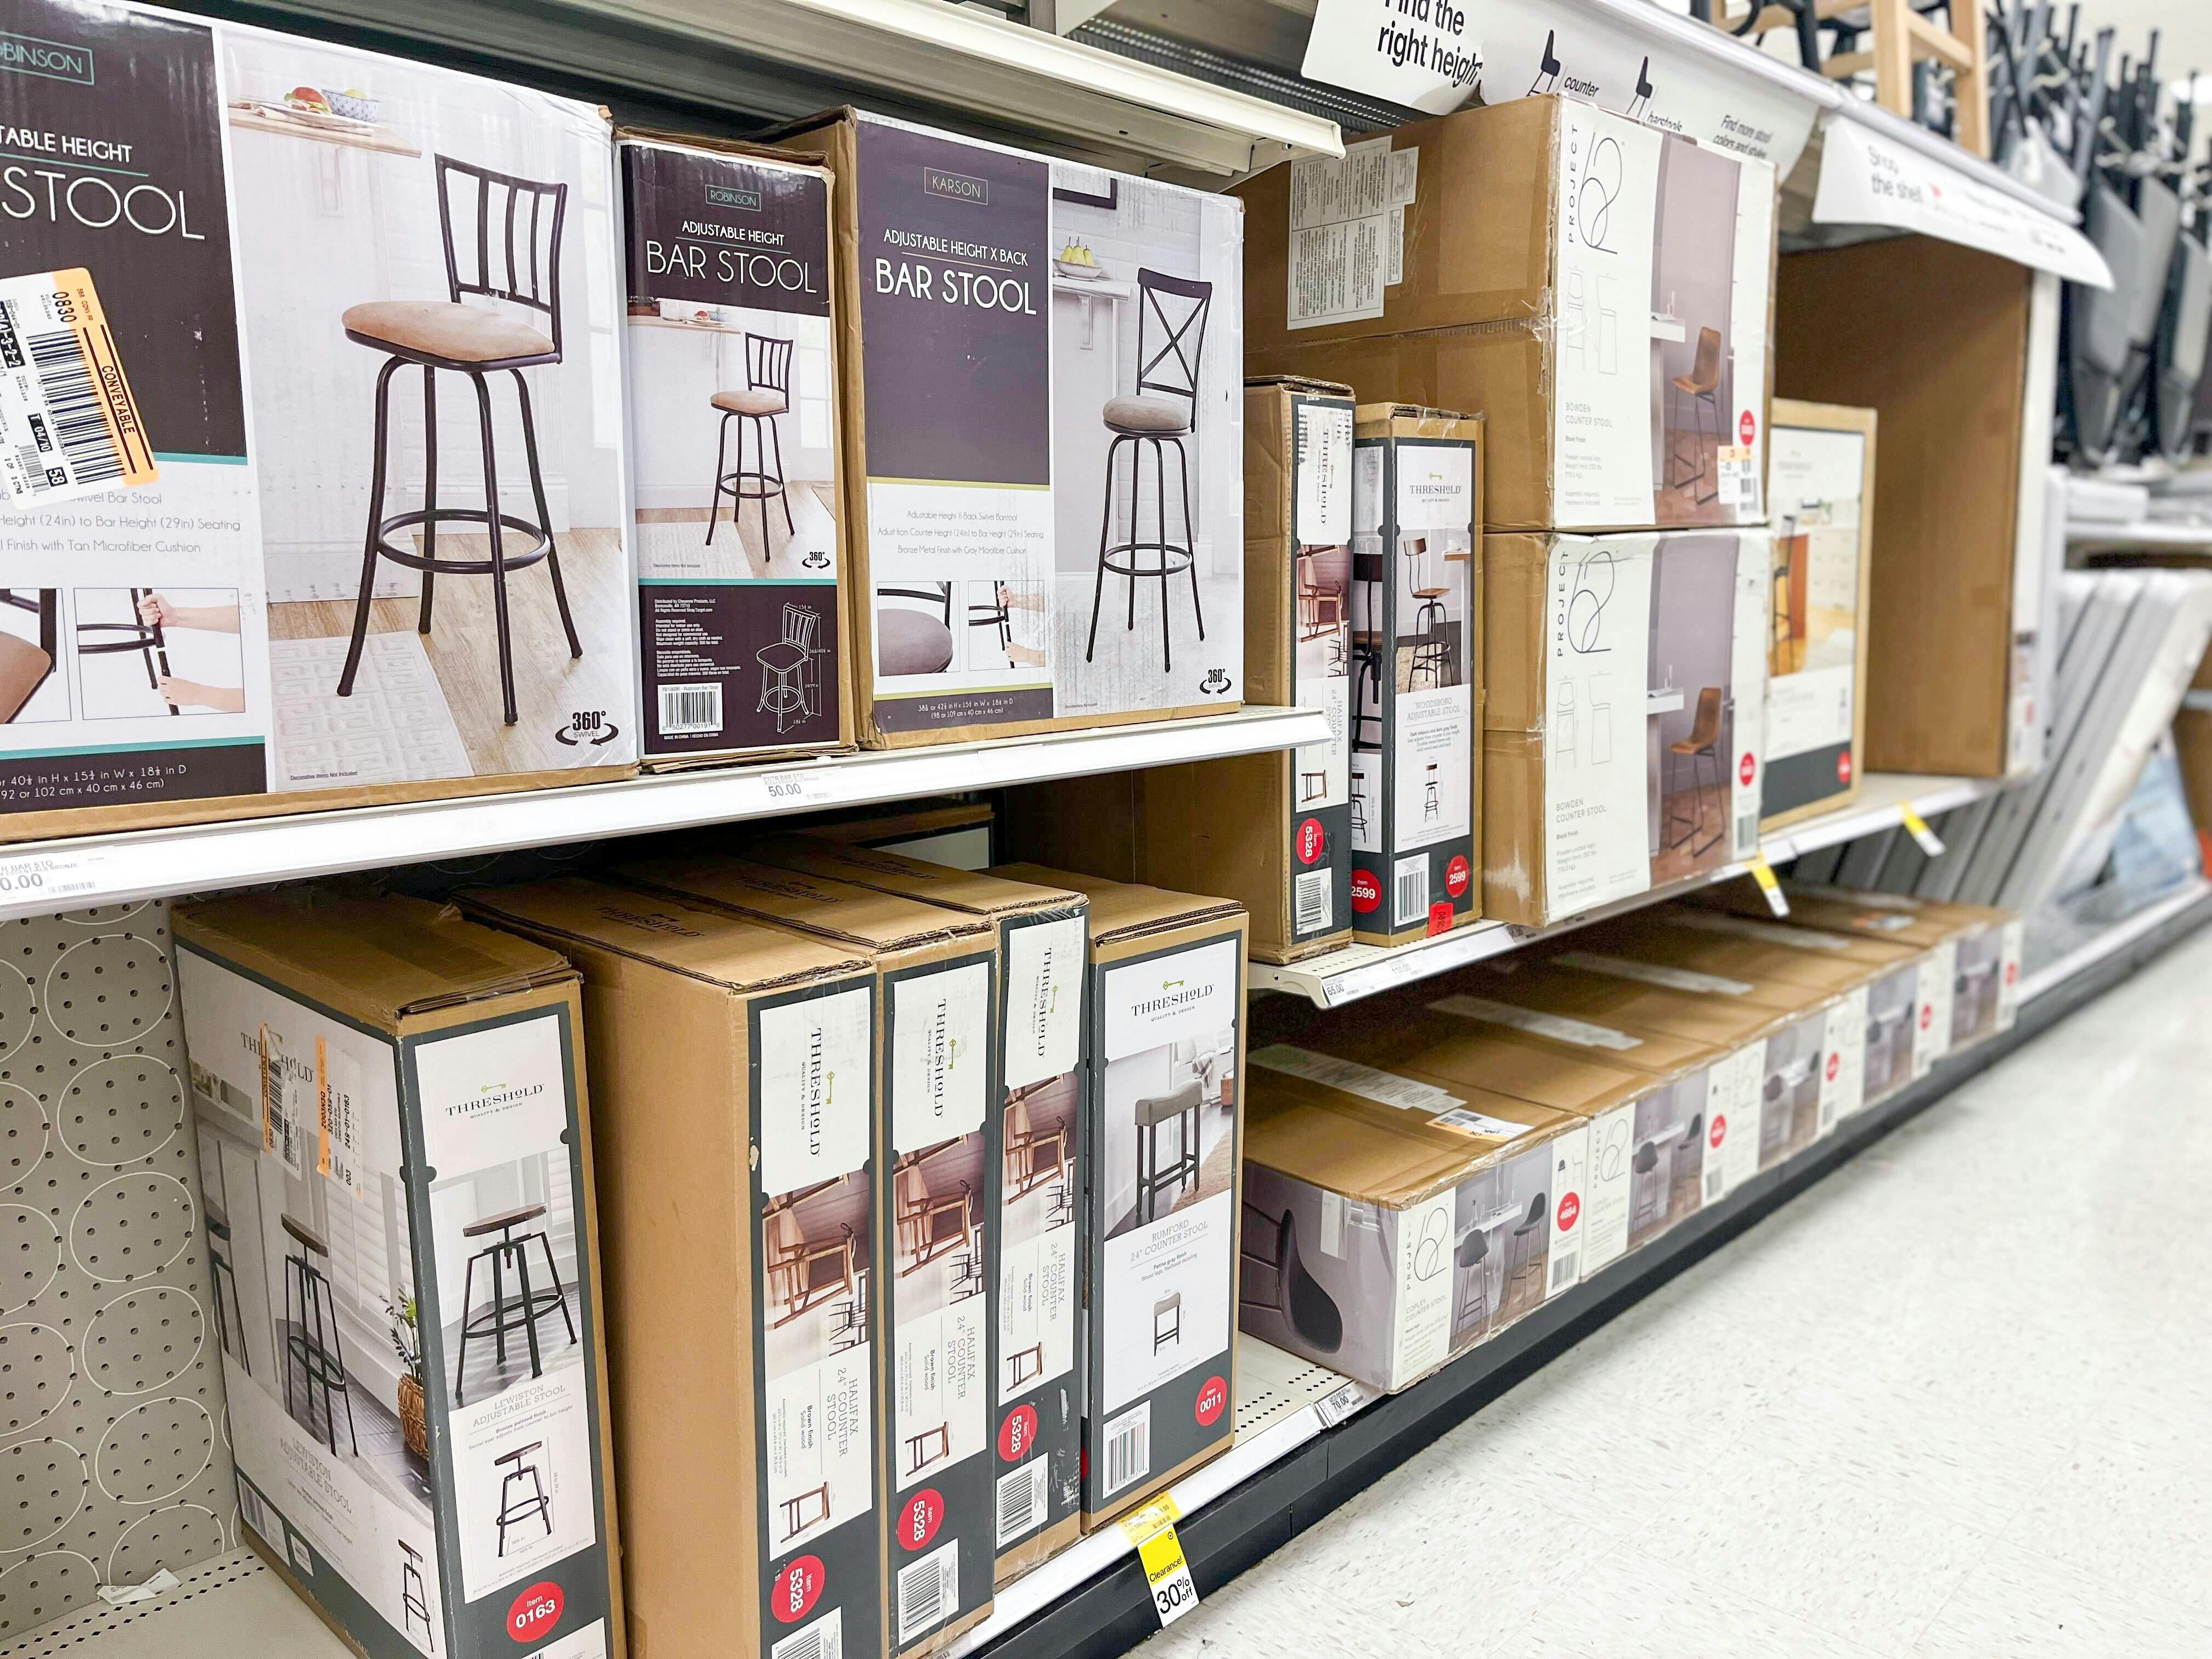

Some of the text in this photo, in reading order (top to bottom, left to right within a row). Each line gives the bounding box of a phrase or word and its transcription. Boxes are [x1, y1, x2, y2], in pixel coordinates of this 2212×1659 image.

[1435, 0, 1464, 36] the
[1378, 21, 1428, 67] right
[1564, 76, 1599, 97] counter
[1721, 114, 1737, 131] Find
[62, 137, 132, 162] HEIGHT
[933, 176, 980, 198] KARSON
[1568, 124, 1578, 242] PROJECT
[2, 166, 205, 240] STOOL
[710, 190, 757, 207] ROBINSON
[682, 221, 785, 246] ADJUSTABLE HEIGHT
[884, 228, 1028, 266] ADJUSTABLE HEIGHT X BACK
[646, 240, 817, 294] BAR STOOL
[876, 258, 1036, 315] BAR STOOL
[53, 292, 77, 323] 0830
[101, 365, 135, 433] CONVEYABLE
[1566, 402, 1591, 413] BOWDEN
[1566, 415, 1612, 428] COUNTER STOOL
[48, 468, 65, 484] 58
[108, 492, 162, 504] Bar Stool
[1409, 486, 1461, 494] THRESHOLD
[40, 515, 240, 532] (24in) to Bar Height (29in) Seating
[907, 511, 956, 521] Adjustable Height
[910, 528, 1006, 538] Counter Height Height
[7, 539, 200, 552] Finish with Tan Microfiber Cushion
[898, 545, 1026, 555] Bronze Cushion
[1558, 551, 1568, 657] PROJECT
[1407, 705, 1460, 721] ADJUSTABLE STOOL
[1416, 697, 1452, 709] WOODSBORO
[52, 774, 59, 782] H
[114, 769, 125, 778] W
[179, 765, 187, 774] D
[35, 787, 55, 797] 102
[87, 784, 100, 793] 40
[130, 781, 142, 789] 46
[146, 778, 164, 789] cm)
[769, 783, 802, 797] 50.00
[1556, 798, 1584, 812] BOWDEN
[1556, 805, 1606, 823] COUNTER STOOL
[1305, 826, 1313, 857] 5328
[1449, 871, 1466, 885] 2599
[1352, 888, 1376, 899] 2599
[1131, 984, 1213, 1017] THRESHOLD
[1327, 984, 1344, 996] 65.00
[1038, 947, 1052, 1058] THRESHOLD
[1151, 1012, 1171, 1022] QUALITY
[934, 998, 946, 1118] THRESHOLD
[445, 1084, 544, 1117] THRESHOLD
[810, 1028, 822, 1157] THRESHOLD
[470, 1102, 523, 1119] QUALITY DESIGN
[1144, 1221, 1208, 1255] COUNTER STOOL
[1152, 1219, 1189, 1243] RUMFORD
[1406, 1304, 1430, 1322] COUNTER
[947, 1340, 956, 1384] STOOL
[967, 1326, 975, 1380] HALIFAX
[957, 1338, 966, 1400] COUNTER
[494, 1384, 544, 1410] LEWISTON
[1200, 1392, 1222, 1413] 0011
[1206, 1387, 1216, 1396] item
[1331, 1396, 1349, 1410] 70.00
[473, 1385, 566, 1427] ADJUSTABLE STOOL
[827, 1393, 836, 1441] STOOL
[849, 1378, 859, 1436] HALIFAX
[514, 1415, 533, 1426] painted
[838, 1392, 848, 1458] COUNTER
[1011, 1414, 1023, 1453] 5328
[324, 1481, 352, 1514] STOOL
[913, 1500, 926, 1542] 5328
[1149, 1555, 1182, 1582] Clearance!
[527, 1595, 543, 1607] item
[789, 1567, 804, 1613] 5328
[1182, 1587, 1193, 1601] off
[516, 1599, 556, 1628] 0163
